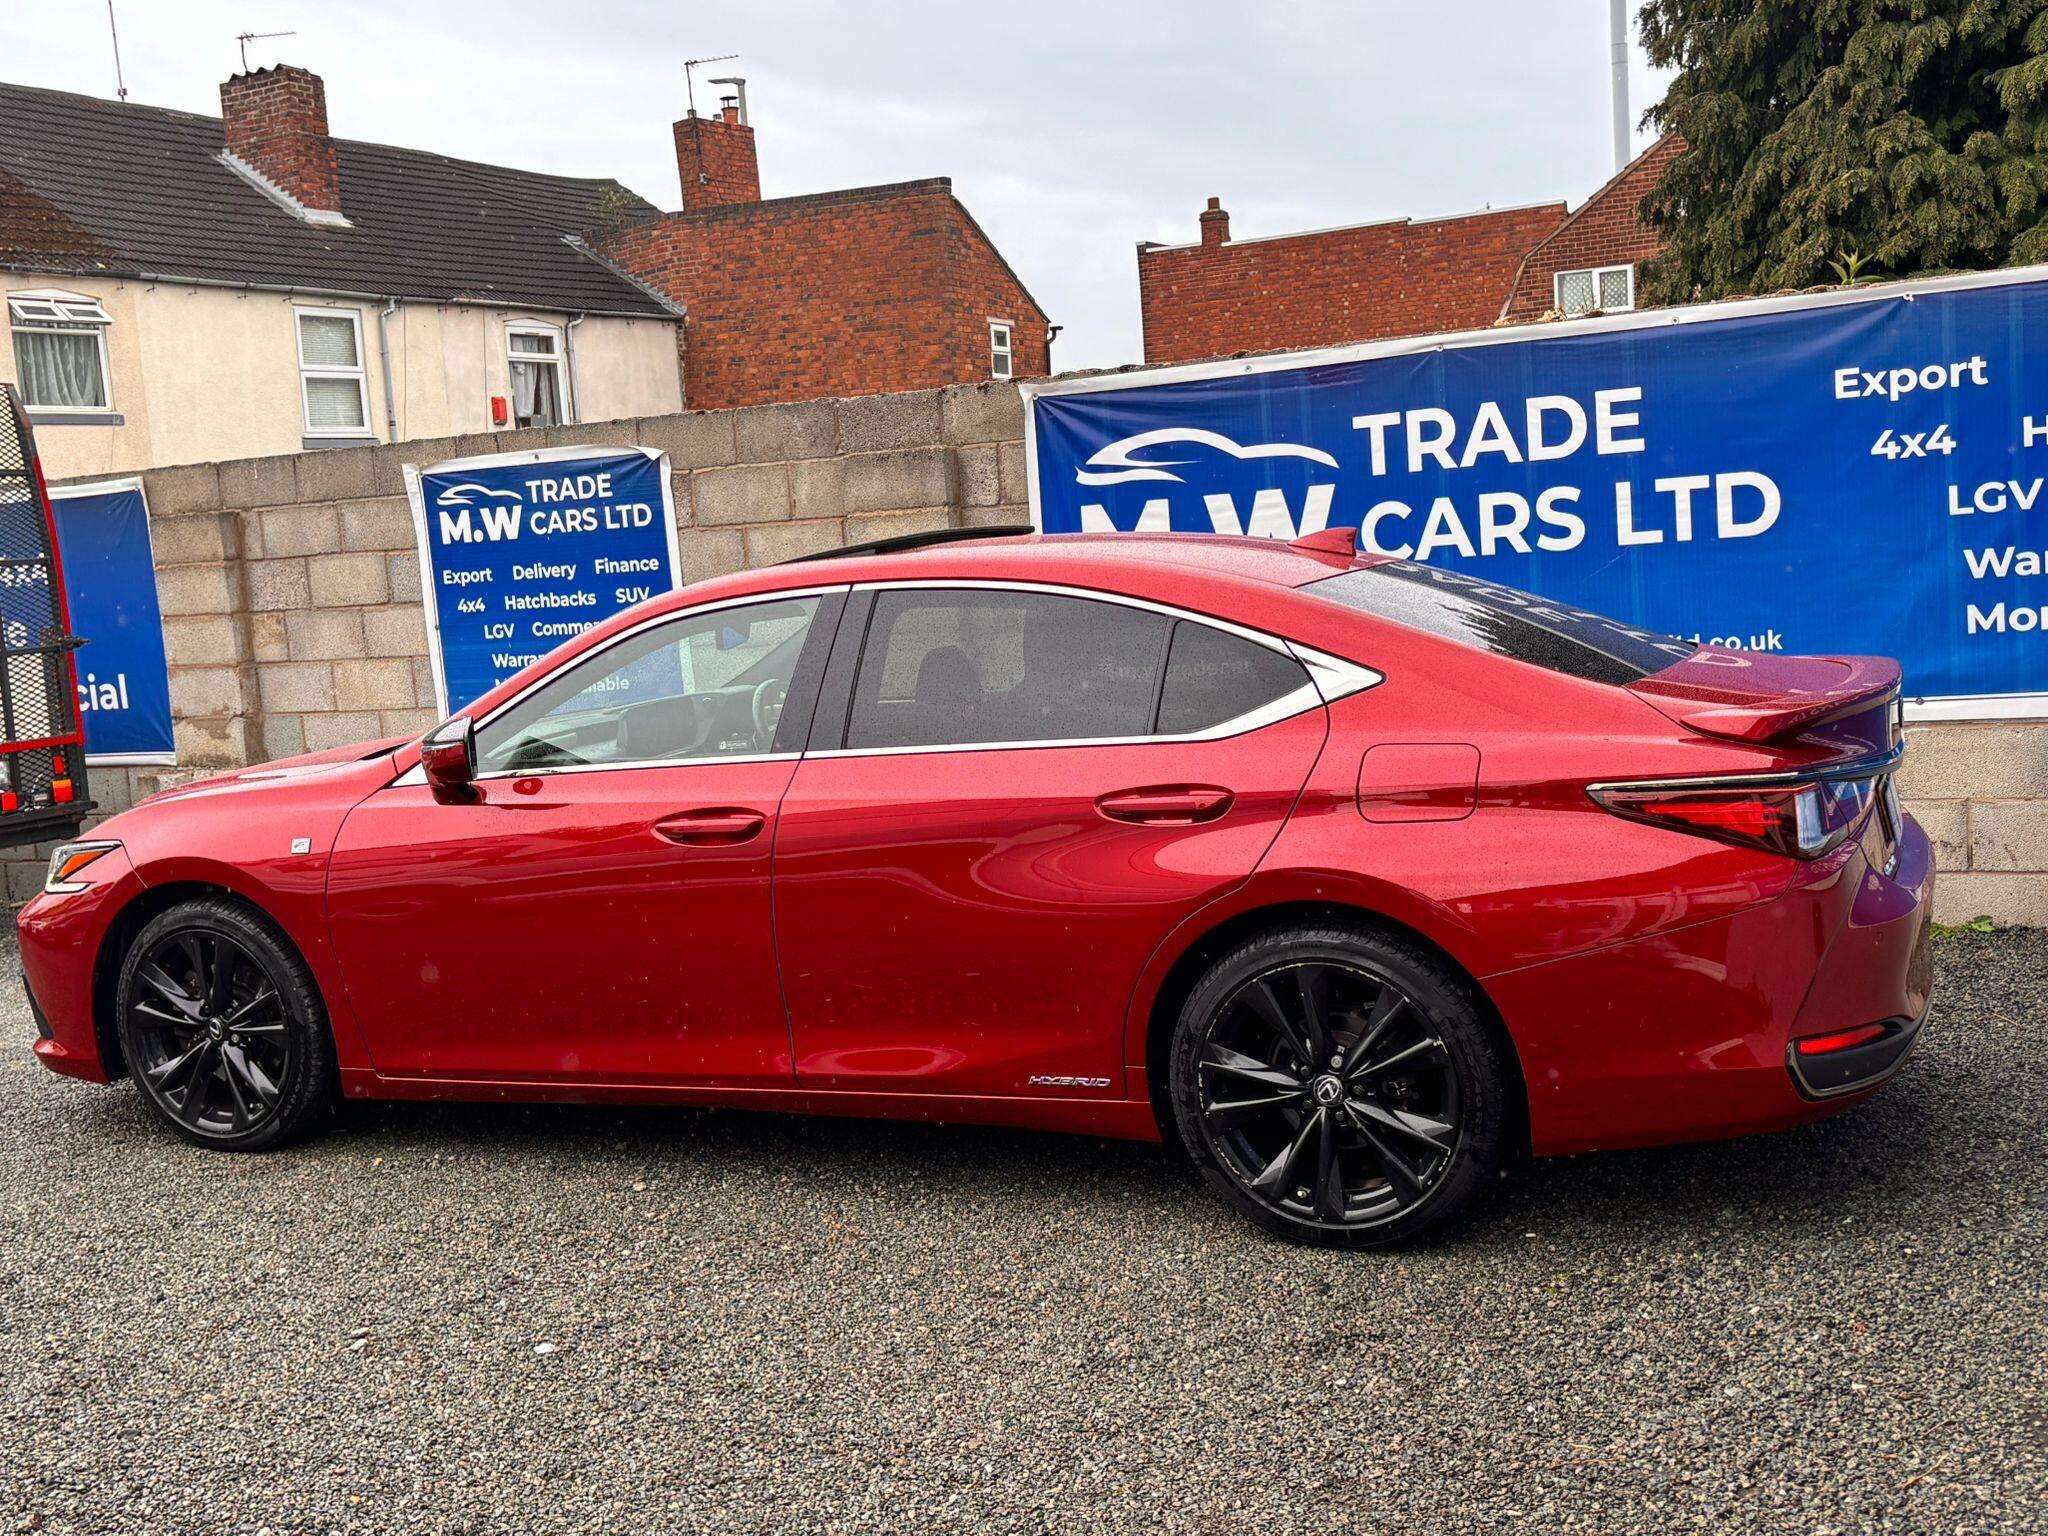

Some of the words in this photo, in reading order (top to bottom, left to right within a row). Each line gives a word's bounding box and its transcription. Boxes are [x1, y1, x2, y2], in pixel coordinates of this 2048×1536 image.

[1835, 356, 1988, 401] Export
[1353, 387, 1646, 476] TRADE
[1871, 425, 1957, 460] 4x4
[525, 473, 614, 504] TRADE
[1949, 478, 2044, 516] LGV
[439, 505, 522, 545] M.W
[530, 507, 598, 535] CARS
[605, 504, 653, 530] LTD
[1361, 486, 1586, 561] CARS
[1616, 472, 1781, 546] LTD
[443, 568, 493, 587] Export
[512, 563, 576, 581] Delivery
[595, 557, 660, 575] Finance
[1963, 546, 2048, 579] Wa
[457, 598, 486, 613] 4x4
[504, 590, 597, 610] Hatchbacks
[616, 587, 650, 604] SUV
[484, 623, 515, 640] LGV
[492, 652, 545, 669] Warra
[77, 673, 130, 712] cial
[1028, 1076, 1111, 1087] HYBRID
